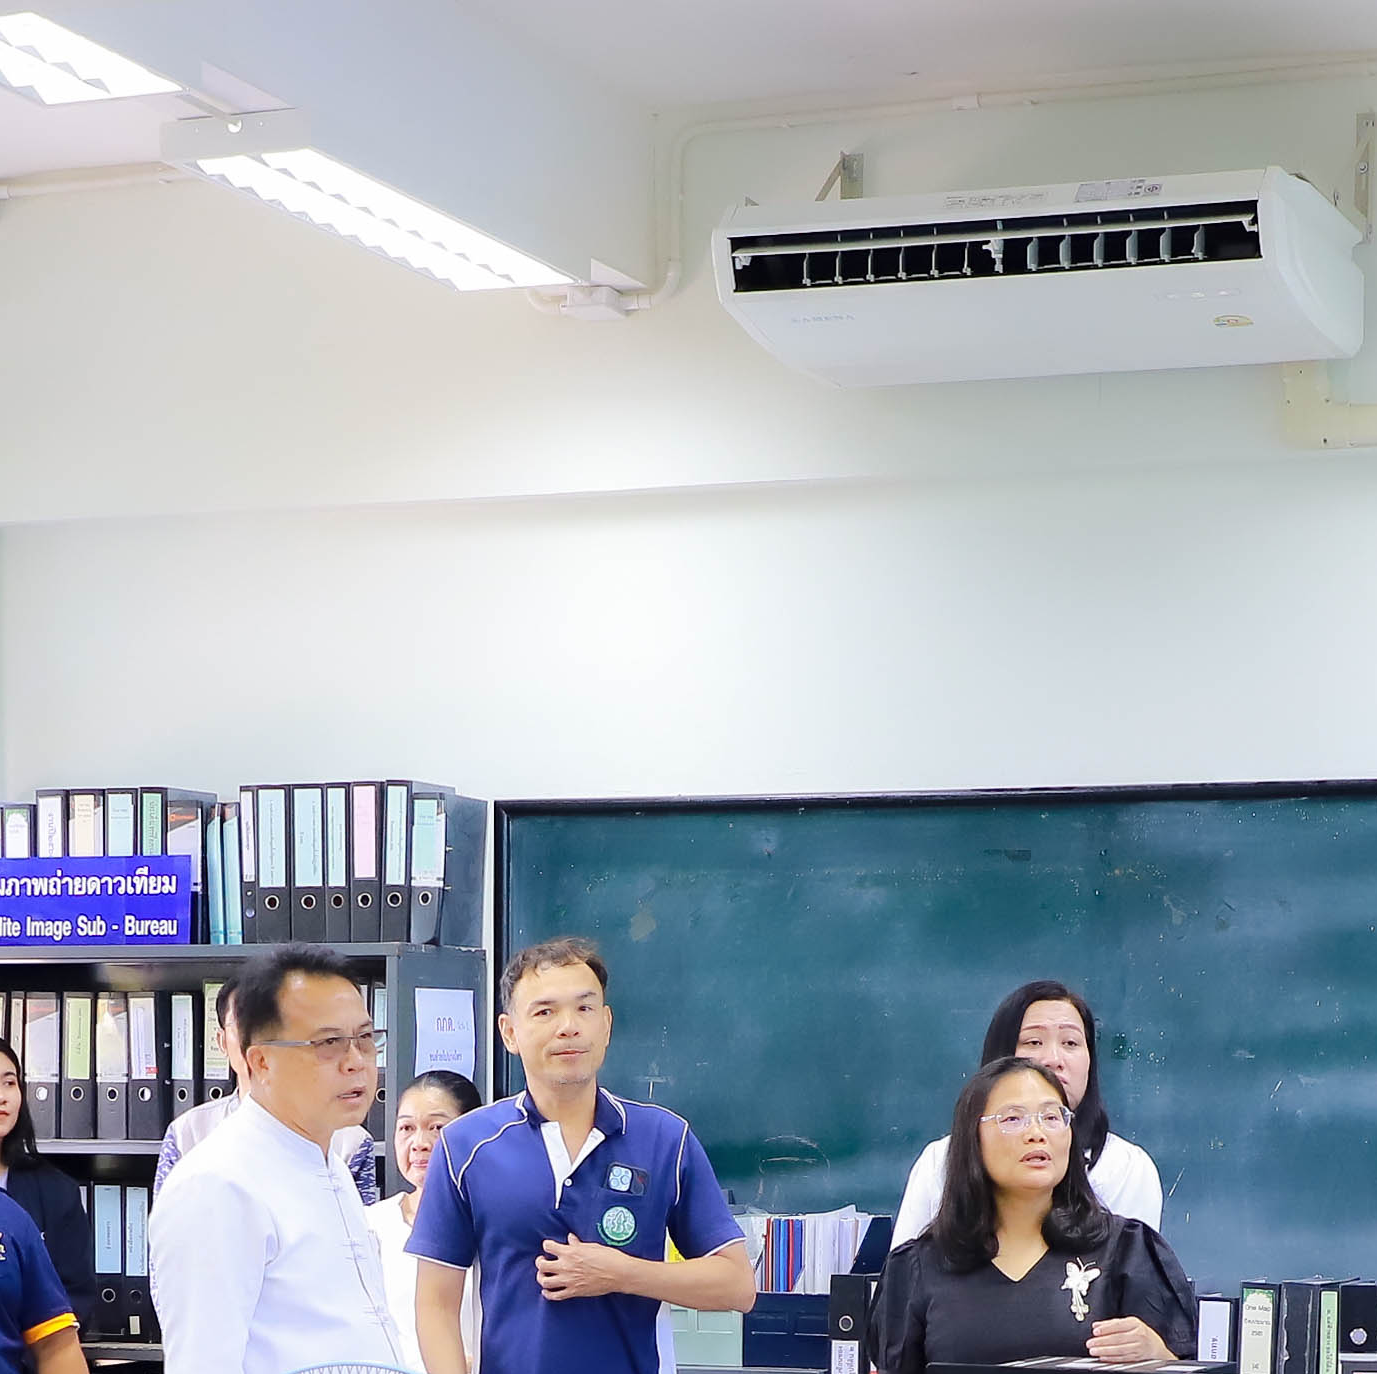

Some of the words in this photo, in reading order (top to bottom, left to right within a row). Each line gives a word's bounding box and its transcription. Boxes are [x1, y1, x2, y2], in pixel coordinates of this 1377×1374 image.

[26, 915, 72, 941] Image
[76, 915, 106, 936] Sub
[124, 915, 178, 937] Bureau
